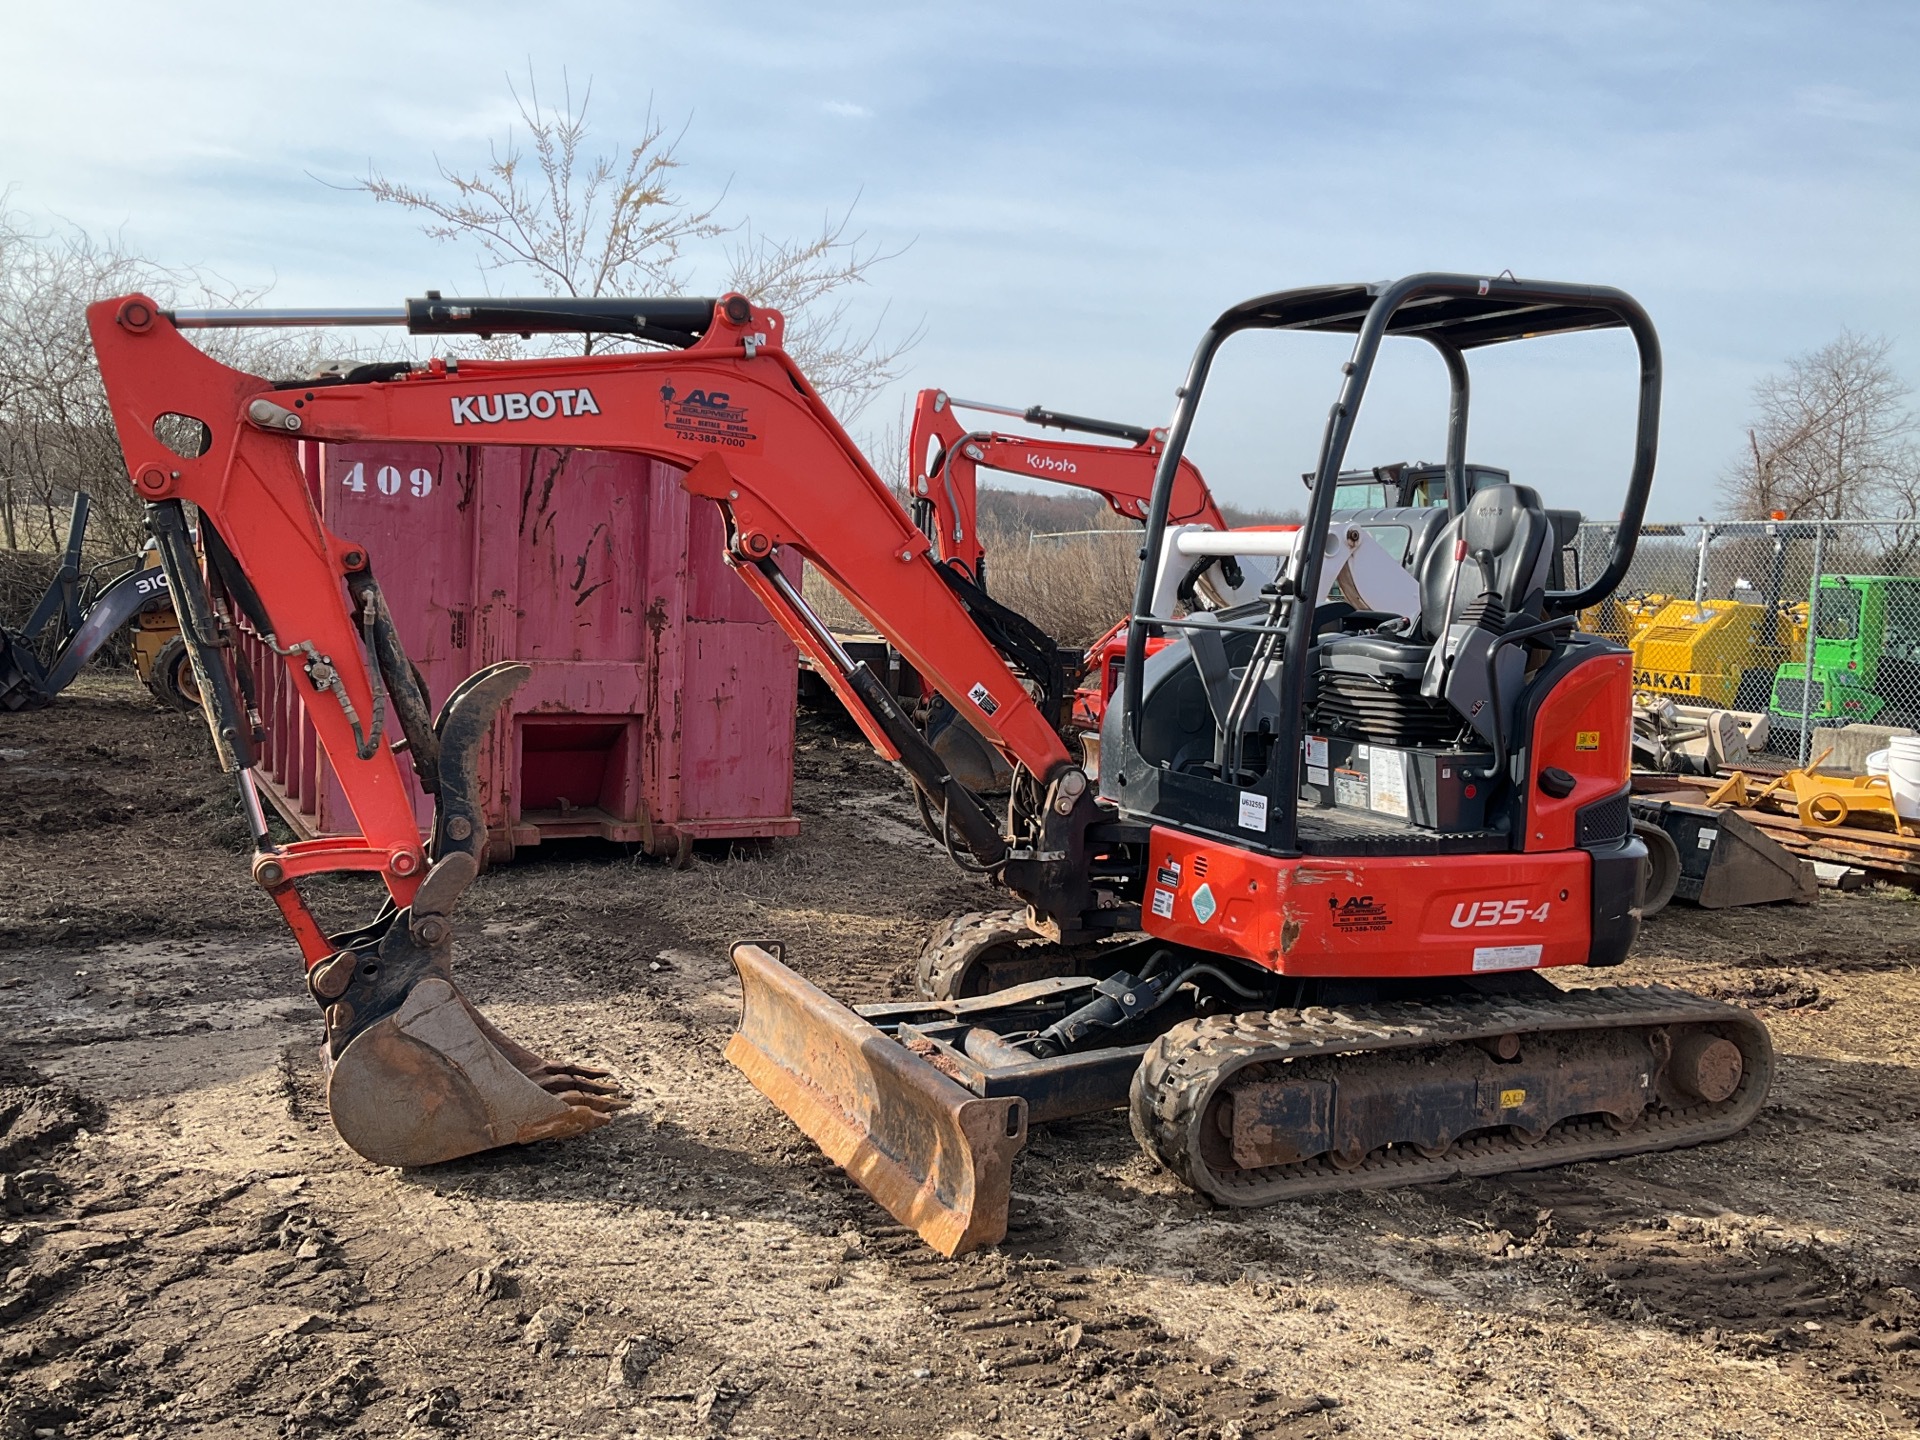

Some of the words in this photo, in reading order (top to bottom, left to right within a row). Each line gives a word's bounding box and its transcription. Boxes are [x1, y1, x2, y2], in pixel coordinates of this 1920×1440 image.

[450, 387, 600, 425] KUBOTA
[683, 389, 730, 409] AC
[682, 405, 741, 420] EQUIPMENT
[676, 430, 745, 447] 732-388-7000
[1027, 453, 1077, 473] Kubota
[342, 462, 433, 498] 409
[1343, 895, 1374, 909] AC
[1450, 899, 1550, 929] U35-4
